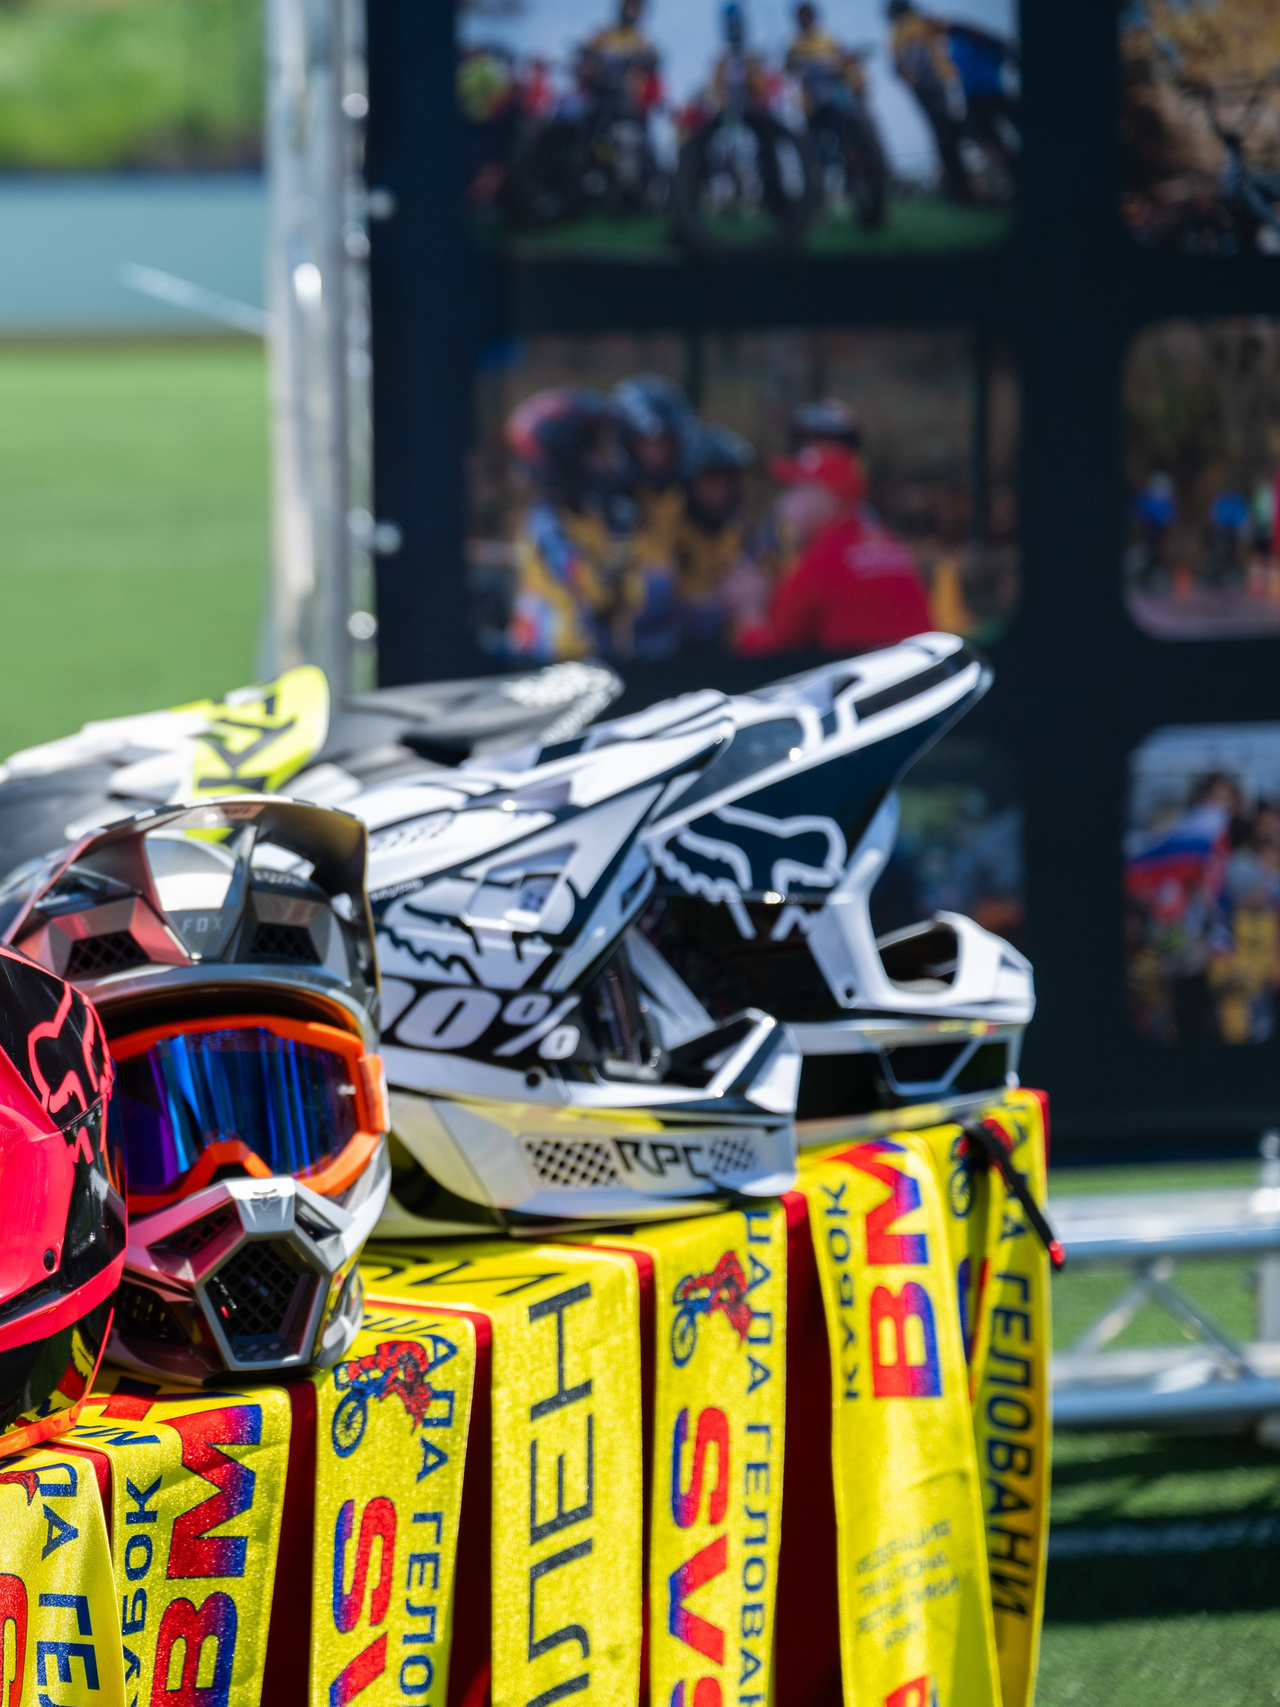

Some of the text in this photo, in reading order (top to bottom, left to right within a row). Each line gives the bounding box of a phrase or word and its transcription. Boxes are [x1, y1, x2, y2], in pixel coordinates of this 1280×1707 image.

[182, 915, 224, 934] FOX
[984, 1270, 1035, 1621] ГЕЛОВАНИ
[36, 1592, 101, 1707] ГЕ
[121, 1472, 164, 1707] УБОК
[398, 1510, 445, 1707] ГЕЛО
[668, 1406, 731, 1707] SV
